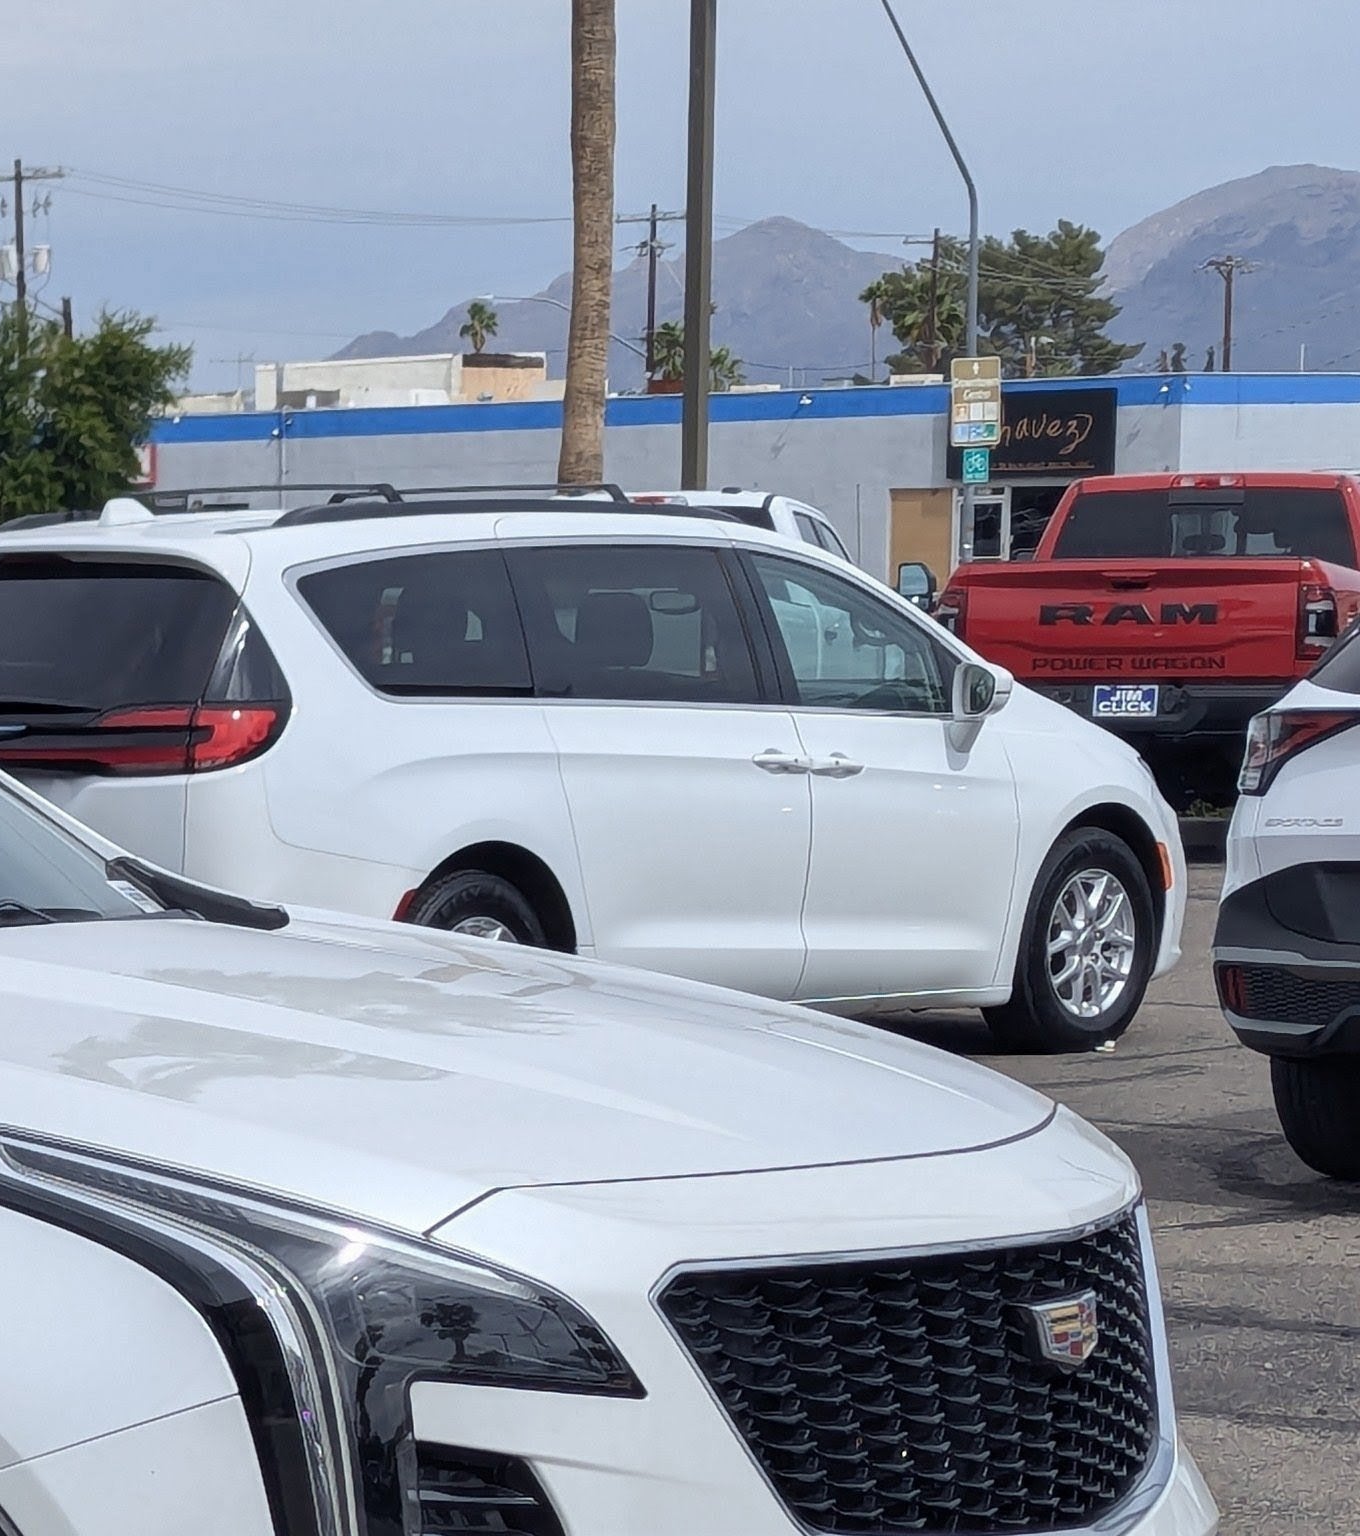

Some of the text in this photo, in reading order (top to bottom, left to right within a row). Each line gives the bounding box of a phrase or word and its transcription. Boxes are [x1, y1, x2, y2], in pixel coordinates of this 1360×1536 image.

[991, 402, 1093, 455] havez
[1038, 602, 1219, 626] RAM
[1032, 655, 1226, 671] POWER WAGON
[1110, 689, 1143, 701] JIM
[1098, 701, 1152, 712] CLICK
